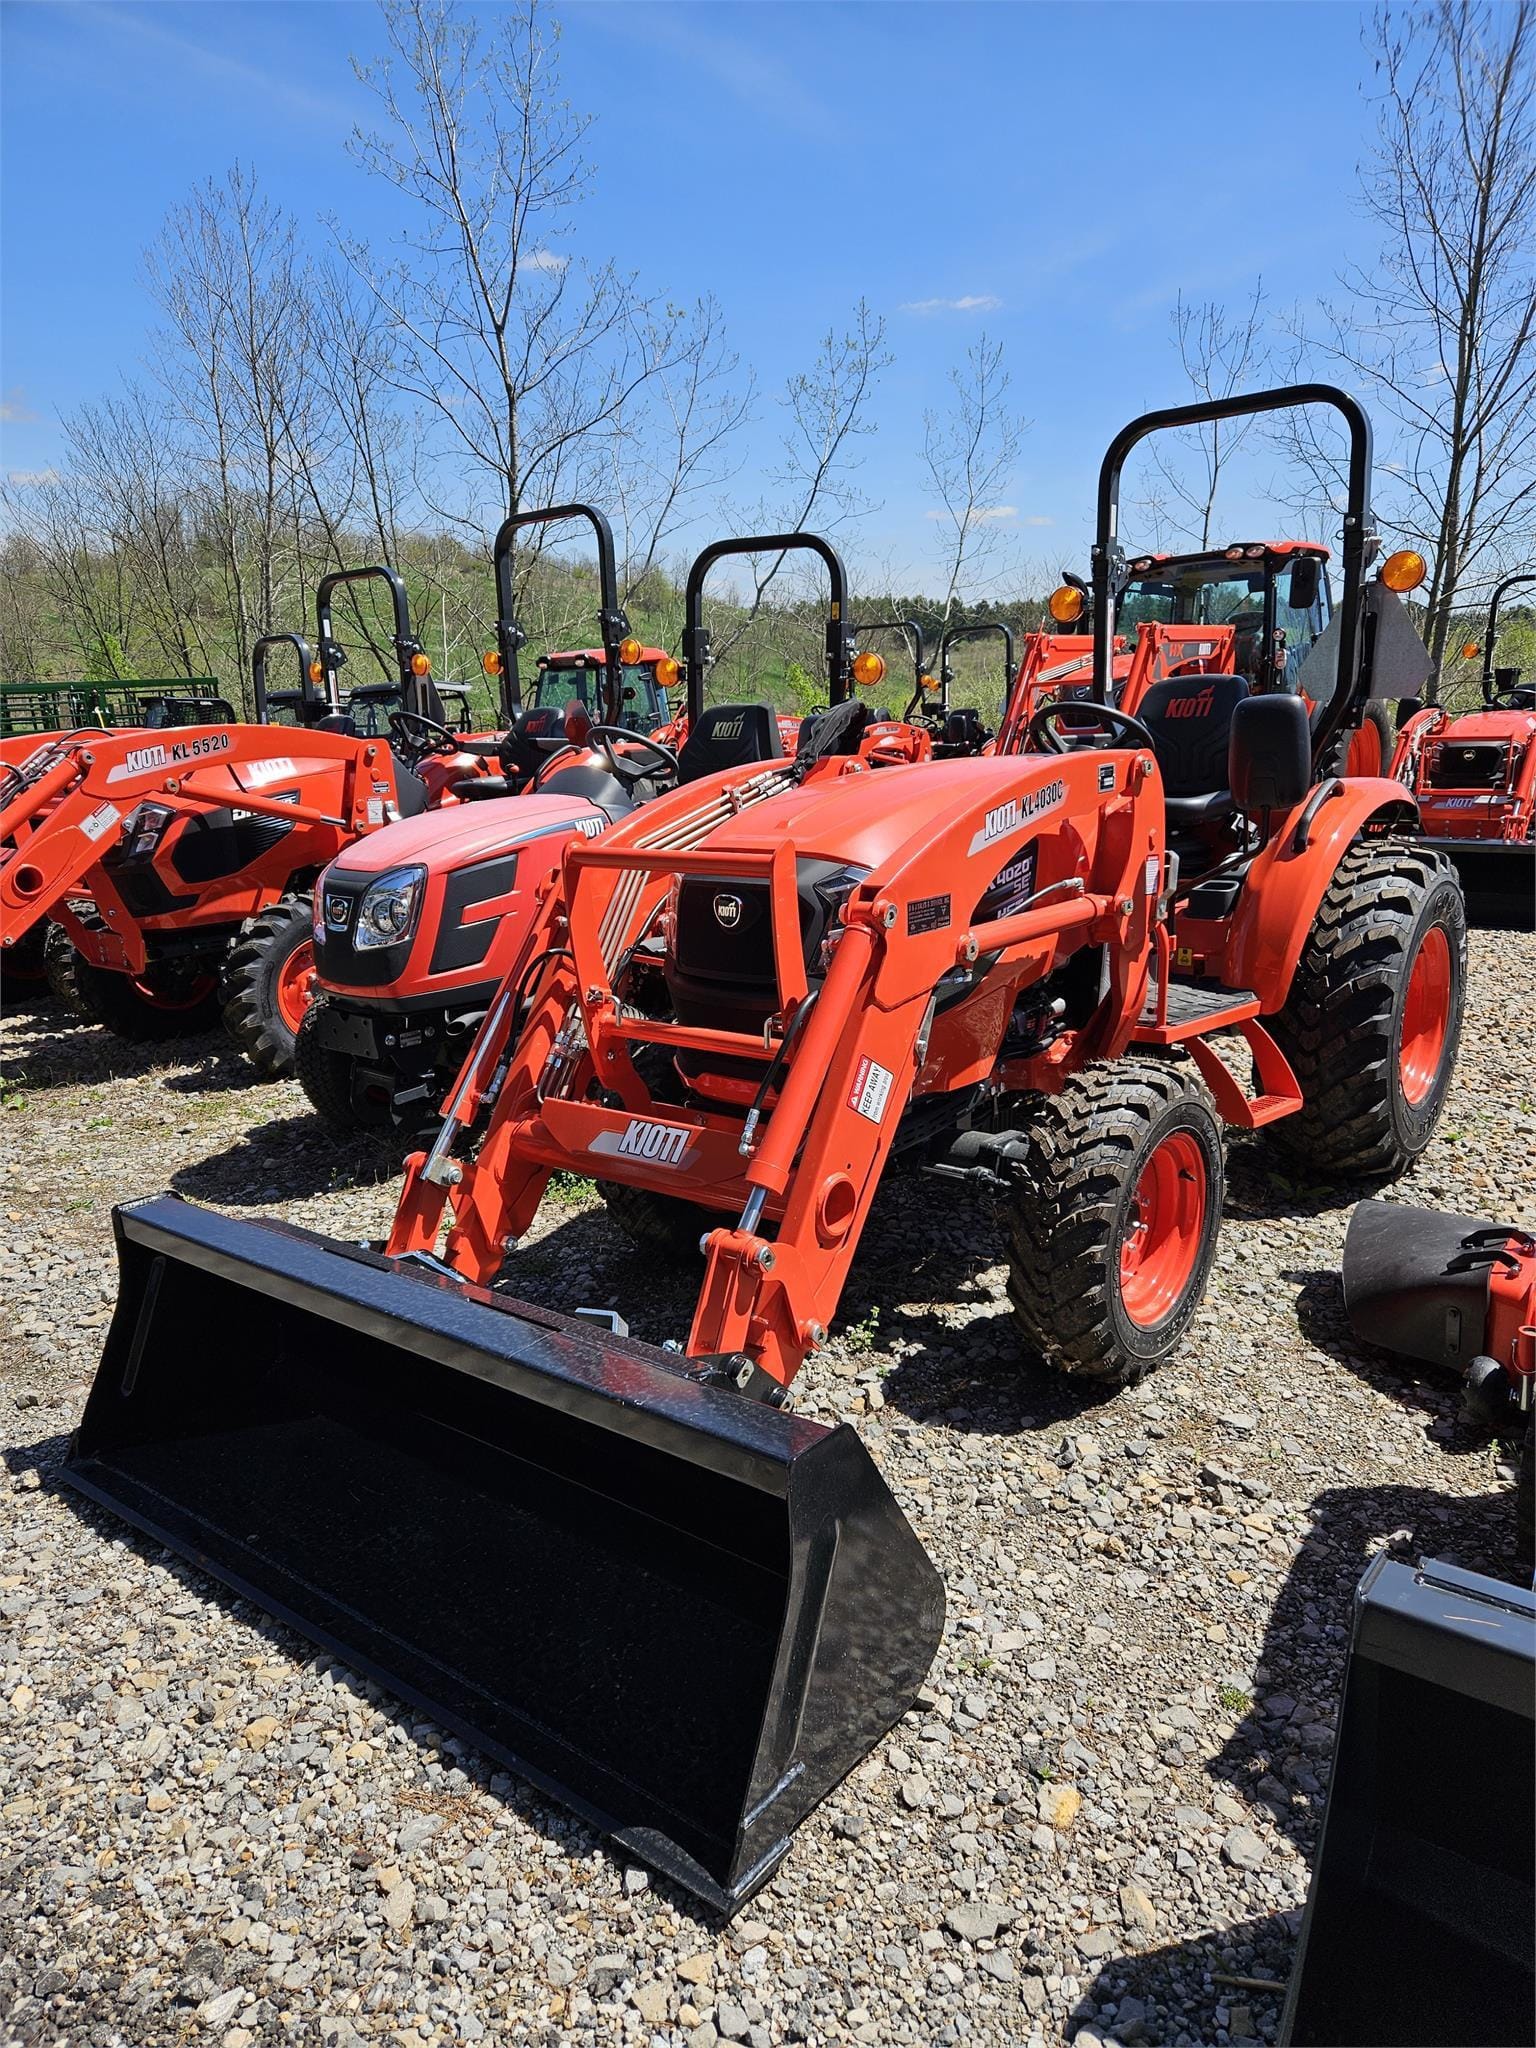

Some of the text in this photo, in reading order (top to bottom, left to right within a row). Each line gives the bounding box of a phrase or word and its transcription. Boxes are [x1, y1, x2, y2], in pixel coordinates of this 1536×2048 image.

[1164, 698, 1215, 719] KIOTI
[711, 721, 744, 737] KIOTI
[126, 745, 167, 773] KIOTI
[984, 779, 1063, 841] KIOTI KL4030C
[1445, 797, 1473, 808] KIOTI
[574, 817, 605, 839] KIOTI
[853, 1058, 869, 1095] WARNING
[861, 1065, 881, 1115] KEEP AWAY
[618, 1119, 691, 1164] KIOTI
